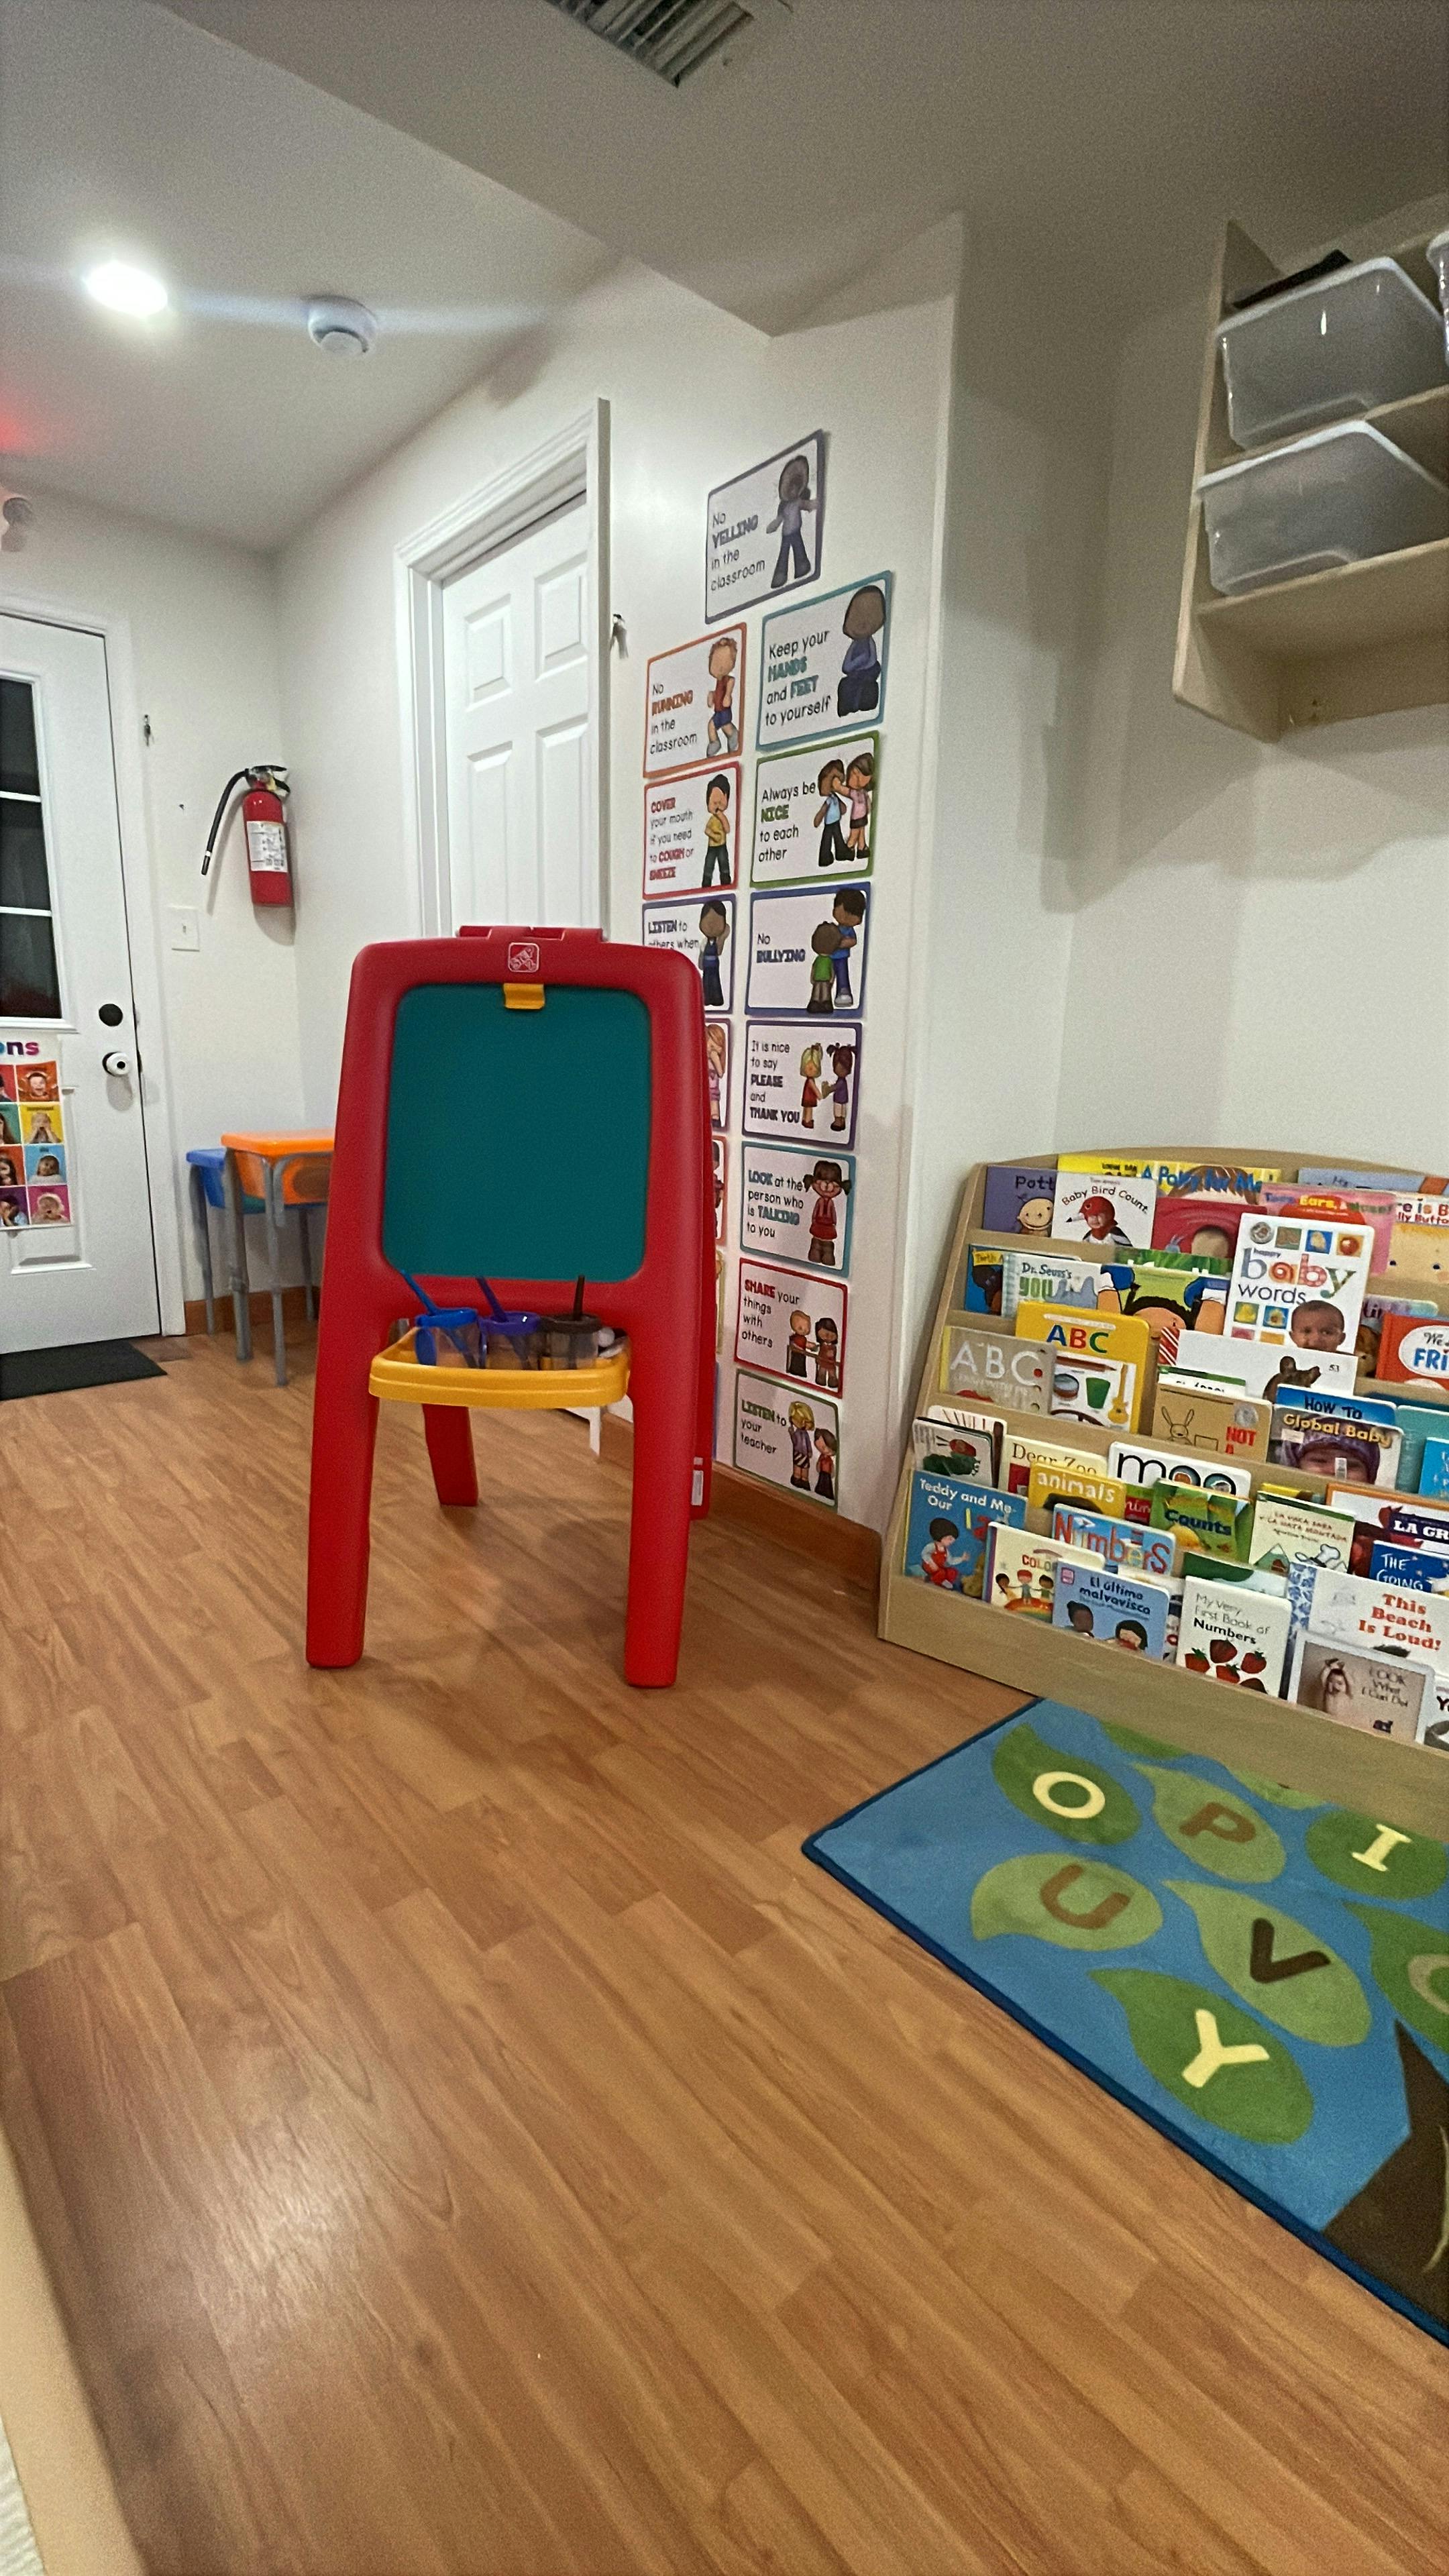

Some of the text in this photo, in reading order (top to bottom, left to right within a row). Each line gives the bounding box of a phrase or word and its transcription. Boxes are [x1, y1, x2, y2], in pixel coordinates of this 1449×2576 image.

[712, 513, 726, 528] No
[712, 515, 758, 549] YELLING
[711, 549, 739, 570] in the
[711, 559, 765, 591] classroom
[769, 631, 830, 659] Keep your
[768, 655, 808, 682] HANDS
[652, 683, 664, 696] No
[767, 686, 788, 704] and
[765, 695, 831, 727] to yourself
[651, 718, 676, 735] in the
[650, 733, 697, 755] classroom
[761, 782, 816, 802] Always be
[651, 797, 676, 813] COVER
[761, 804, 790, 823] NICE
[657, 834, 671, 847] you
[760, 824, 799, 842] to each
[686, 848, 694, 858] or
[758, 847, 787, 862] other
[649, 920, 688, 934] LISTEN to
[678, 938, 699, 949] when
[757, 932, 771, 945] No
[756, 949, 806, 963] BULLYING
[751, 1040, 790, 1054] It is nice
[751, 1057, 777, 1071] to say
[751, 1073, 784, 1088] PLEASE
[750, 1091, 765, 1103] and
[750, 1107, 800, 1124] THANK YOU
[748, 1169, 804, 1191] LOOK at the
[748, 1190, 804, 1210] person who
[1062, 1189, 1087, 1206] Baby
[1091, 1185, 1116, 1195] Bird
[747, 1204, 800, 1226] is TALKING
[747, 1222, 775, 1238] to you
[1022, 1262, 1072, 1279] Dr. Seuss's
[1240, 1247, 1356, 1299] baby
[745, 1279, 800, 1305] SHARE your
[1238, 1284, 1306, 1305] words
[743, 1295, 771, 1315] things
[743, 1314, 763, 1328] with
[741, 1330, 773, 1348] others
[1046, 1324, 1109, 1354] ABC
[1329, 1364, 1340, 1372] 53
[741, 1399, 787, 1426] LISTEN to
[741, 1418, 762, 1432] your
[1283, 1414, 1393, 1449] Global Baby
[741, 1433, 777, 1454] teacher
[1226, 1426, 1256, 1446] NOT
[1117, 1453, 1236, 1496] moo
[920, 1478, 958, 1500] Teddy
[961, 1493, 987, 1507] and
[1038, 1472, 1116, 1503] animals
[928, 1495, 953, 1511] Our
[1165, 1509, 1232, 1536] Counts
[1393, 1520, 1418, 1534] LA
[1381, 1553, 1411, 1571] THE
[1090, 1576, 1100, 1588] El
[1079, 1587, 1150, 1615] malvavisco
[1196, 1593, 1242, 1617] My Very
[1382, 1593, 1426, 1615] This
[1195, 1605, 1271, 1635] First Book of
[1371, 1606, 1432, 1633] Beach
[1193, 1617, 1256, 1644] Numbers
[1358, 1619, 1442, 1651] Is Loud!
[1032, 1771, 1106, 1819] O
[1179, 1802, 1257, 1843] P
[1351, 1823, 1412, 1872] I
[1039, 1864, 1131, 1930] U
[1250, 1918, 1332, 1984] V
[1181, 2008, 1270, 2088] Y
